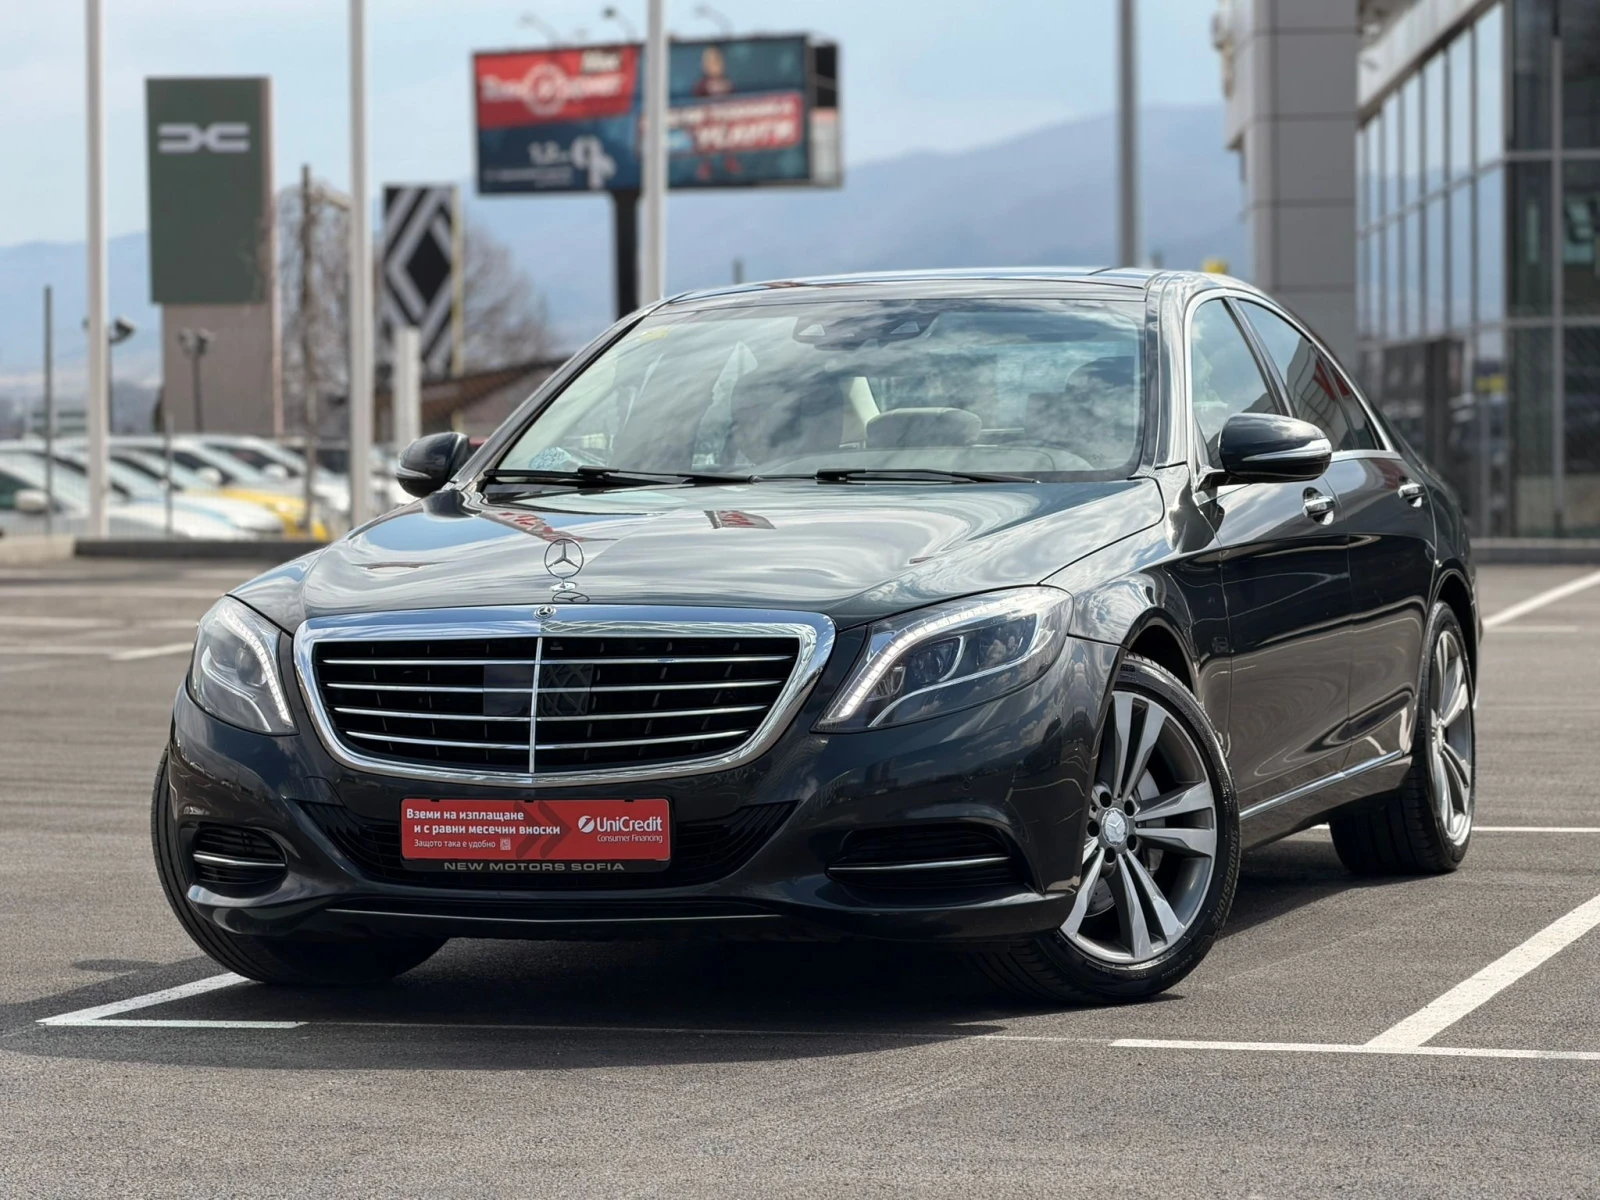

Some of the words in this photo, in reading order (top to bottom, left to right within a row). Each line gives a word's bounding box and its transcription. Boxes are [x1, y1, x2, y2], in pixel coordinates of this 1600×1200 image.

[406, 808, 441, 819] Вземи
[443, 811, 457, 819] на
[459, 811, 524, 822] изплащане
[596, 816, 663, 832] UniCredit
[413, 825, 421, 833] и
[423, 825, 430, 833] с
[432, 825, 466, 835] равни
[468, 826, 516, 834] месечни
[519, 826, 561, 834] вноски
[414, 839, 442, 848] Защото
[444, 840, 461, 848] така
[469, 839, 496, 849] удобно
[597, 834, 630, 843] Consumer
[631, 834, 663, 844] Financing
[443, 862, 484, 871] NEW
[489, 862, 566, 871] MOTORS
[570, 862, 626, 871] SOFIA
[1211, 827, 1239, 927] BRIDGESTONE
